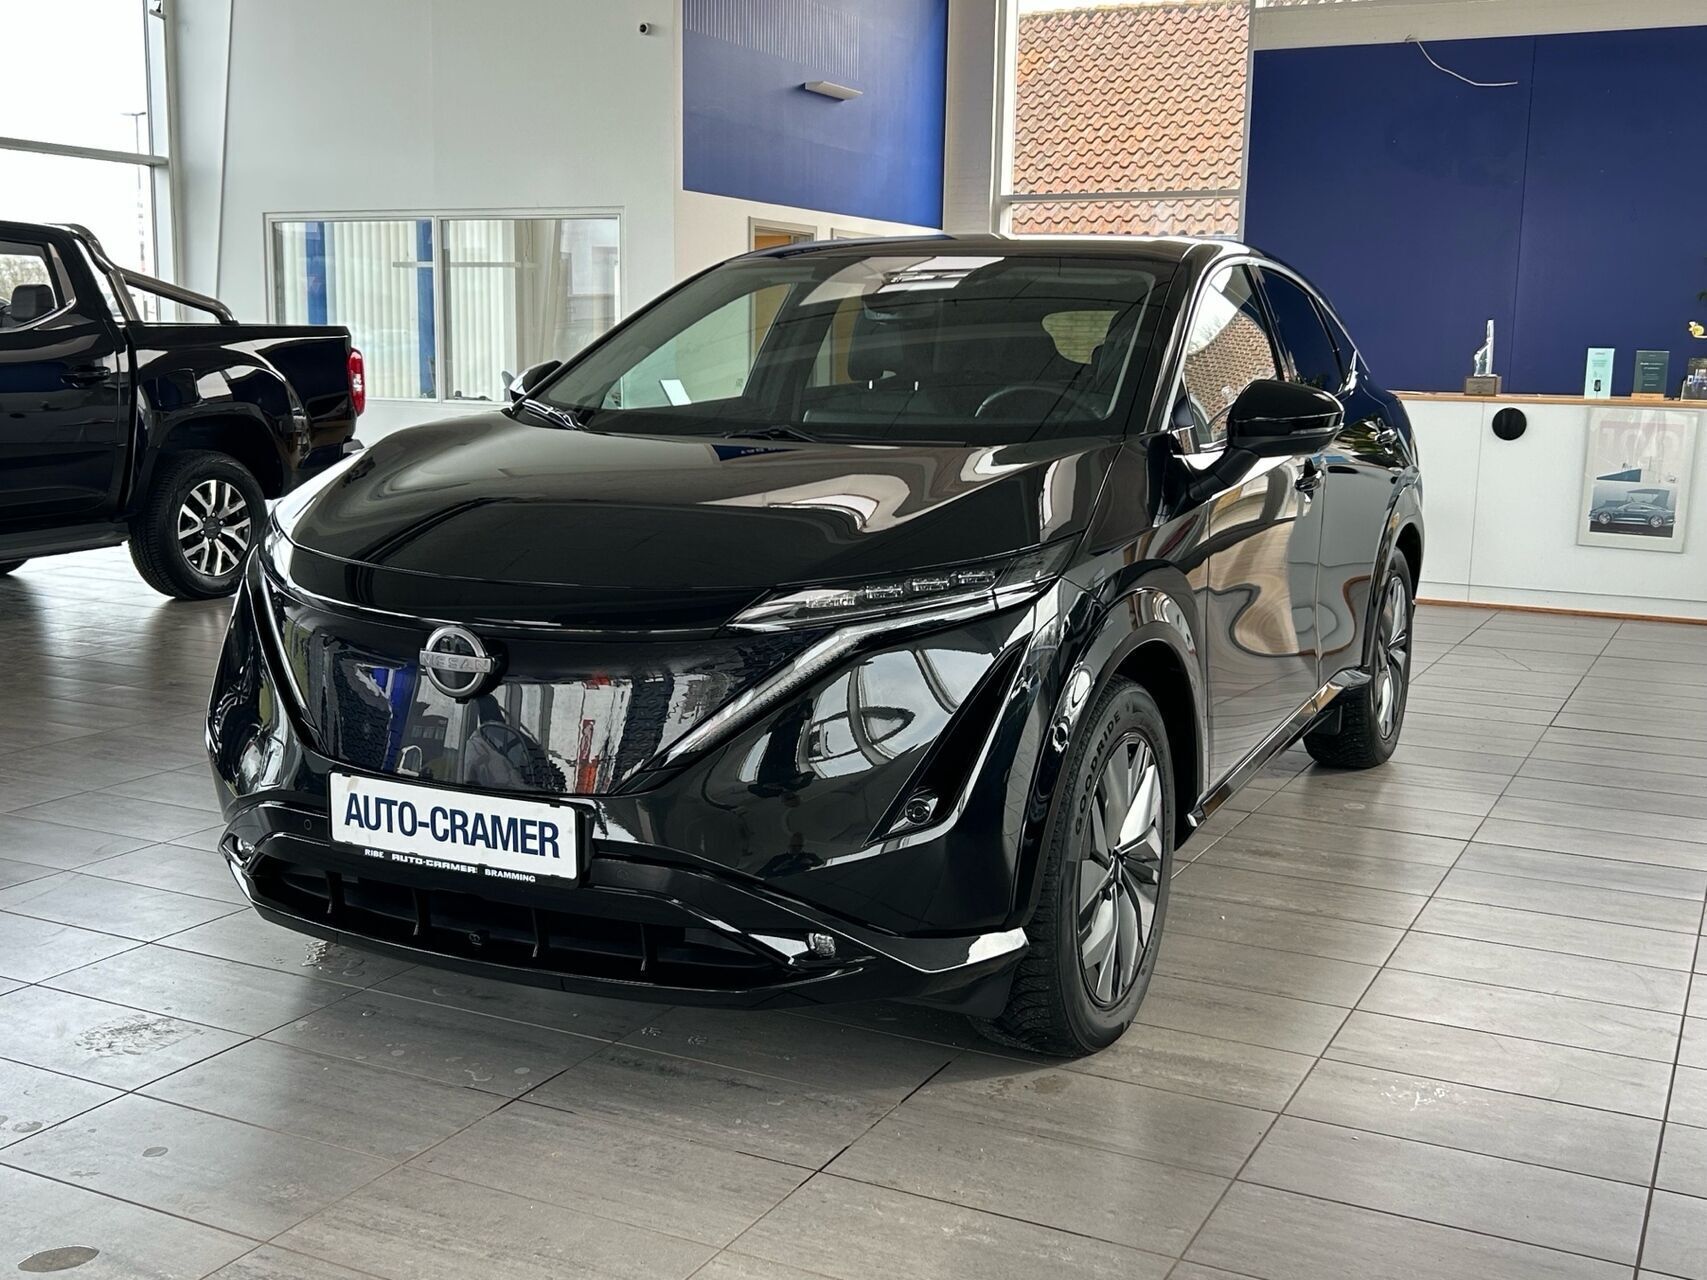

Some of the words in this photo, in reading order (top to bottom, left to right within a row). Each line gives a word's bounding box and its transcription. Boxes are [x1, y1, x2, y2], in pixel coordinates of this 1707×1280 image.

[1075, 710, 1121, 836] GOODRIDE
[344, 793, 560, 858] AUTO-CRAMER
[364, 848, 384, 859] RIBE
[391, 853, 476, 873] AUTO-CRAMER
[484, 868, 536, 883] BRAMMING
